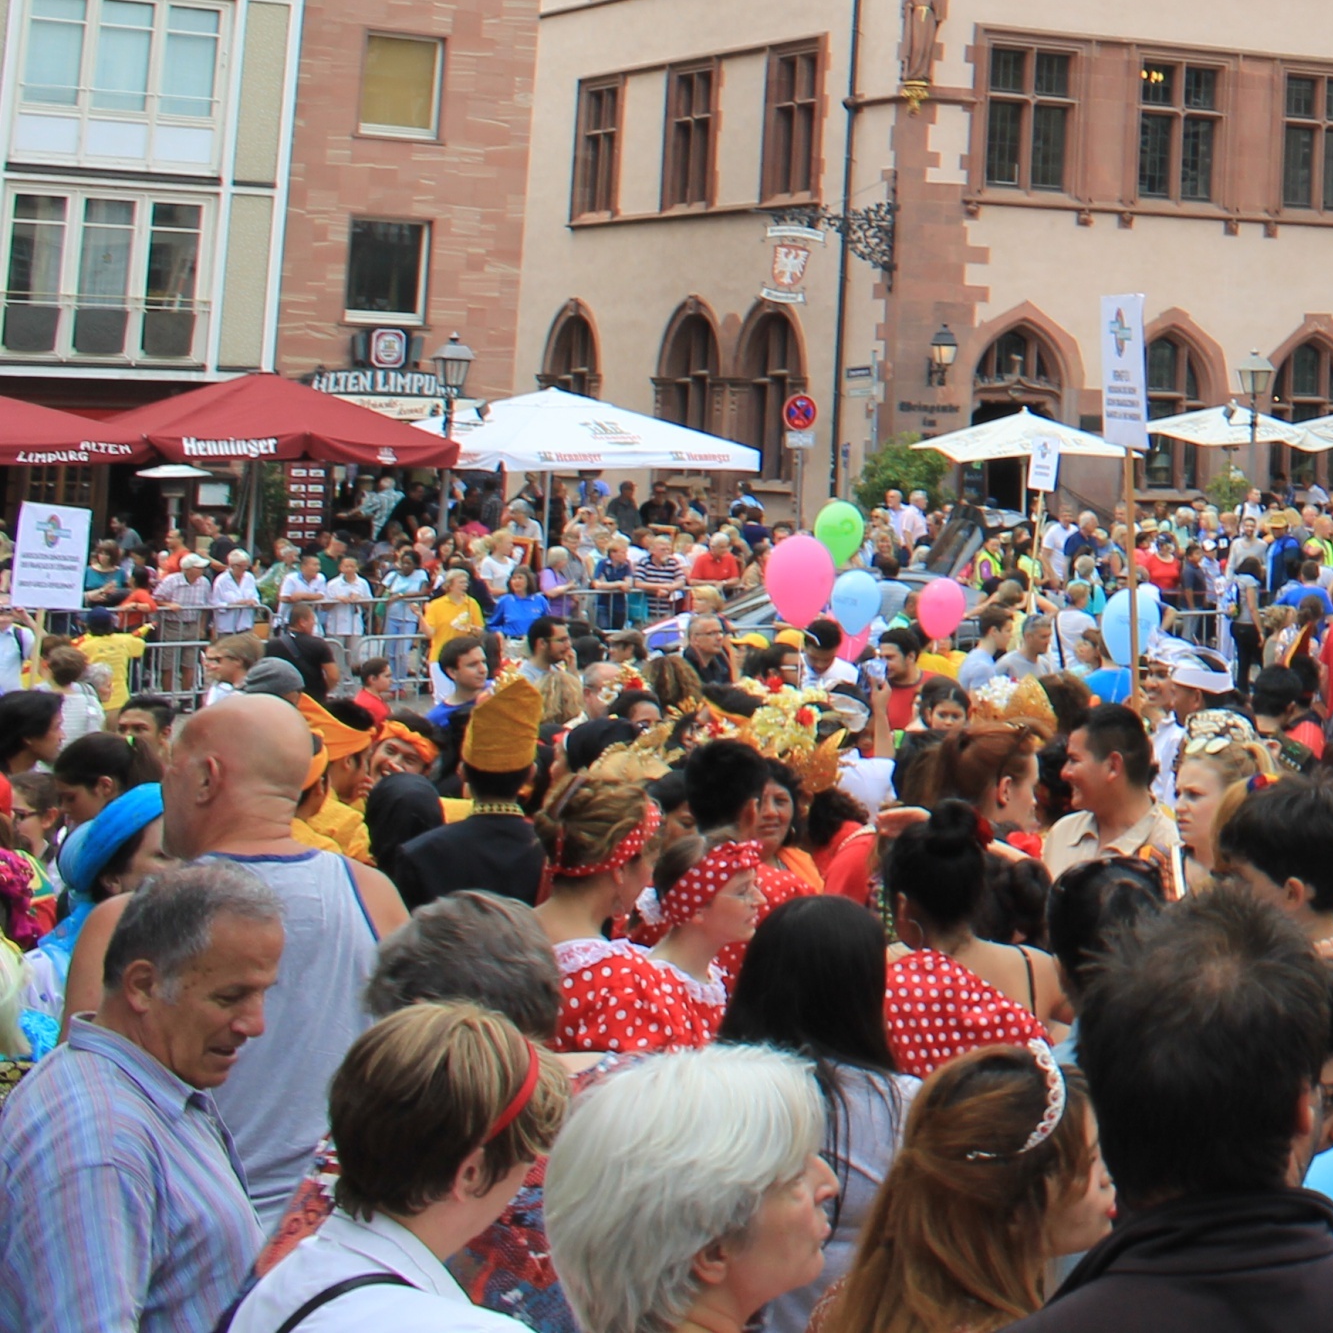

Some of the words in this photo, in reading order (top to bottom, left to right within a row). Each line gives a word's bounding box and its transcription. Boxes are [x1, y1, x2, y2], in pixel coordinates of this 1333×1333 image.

[80, 440, 133, 455] ALTEN
[182, 437, 278, 458] Henninger
[16, 449, 90, 464] LIMPURG
[555, 452, 603, 464] Henninger
[687, 452, 731, 464] Henninger
